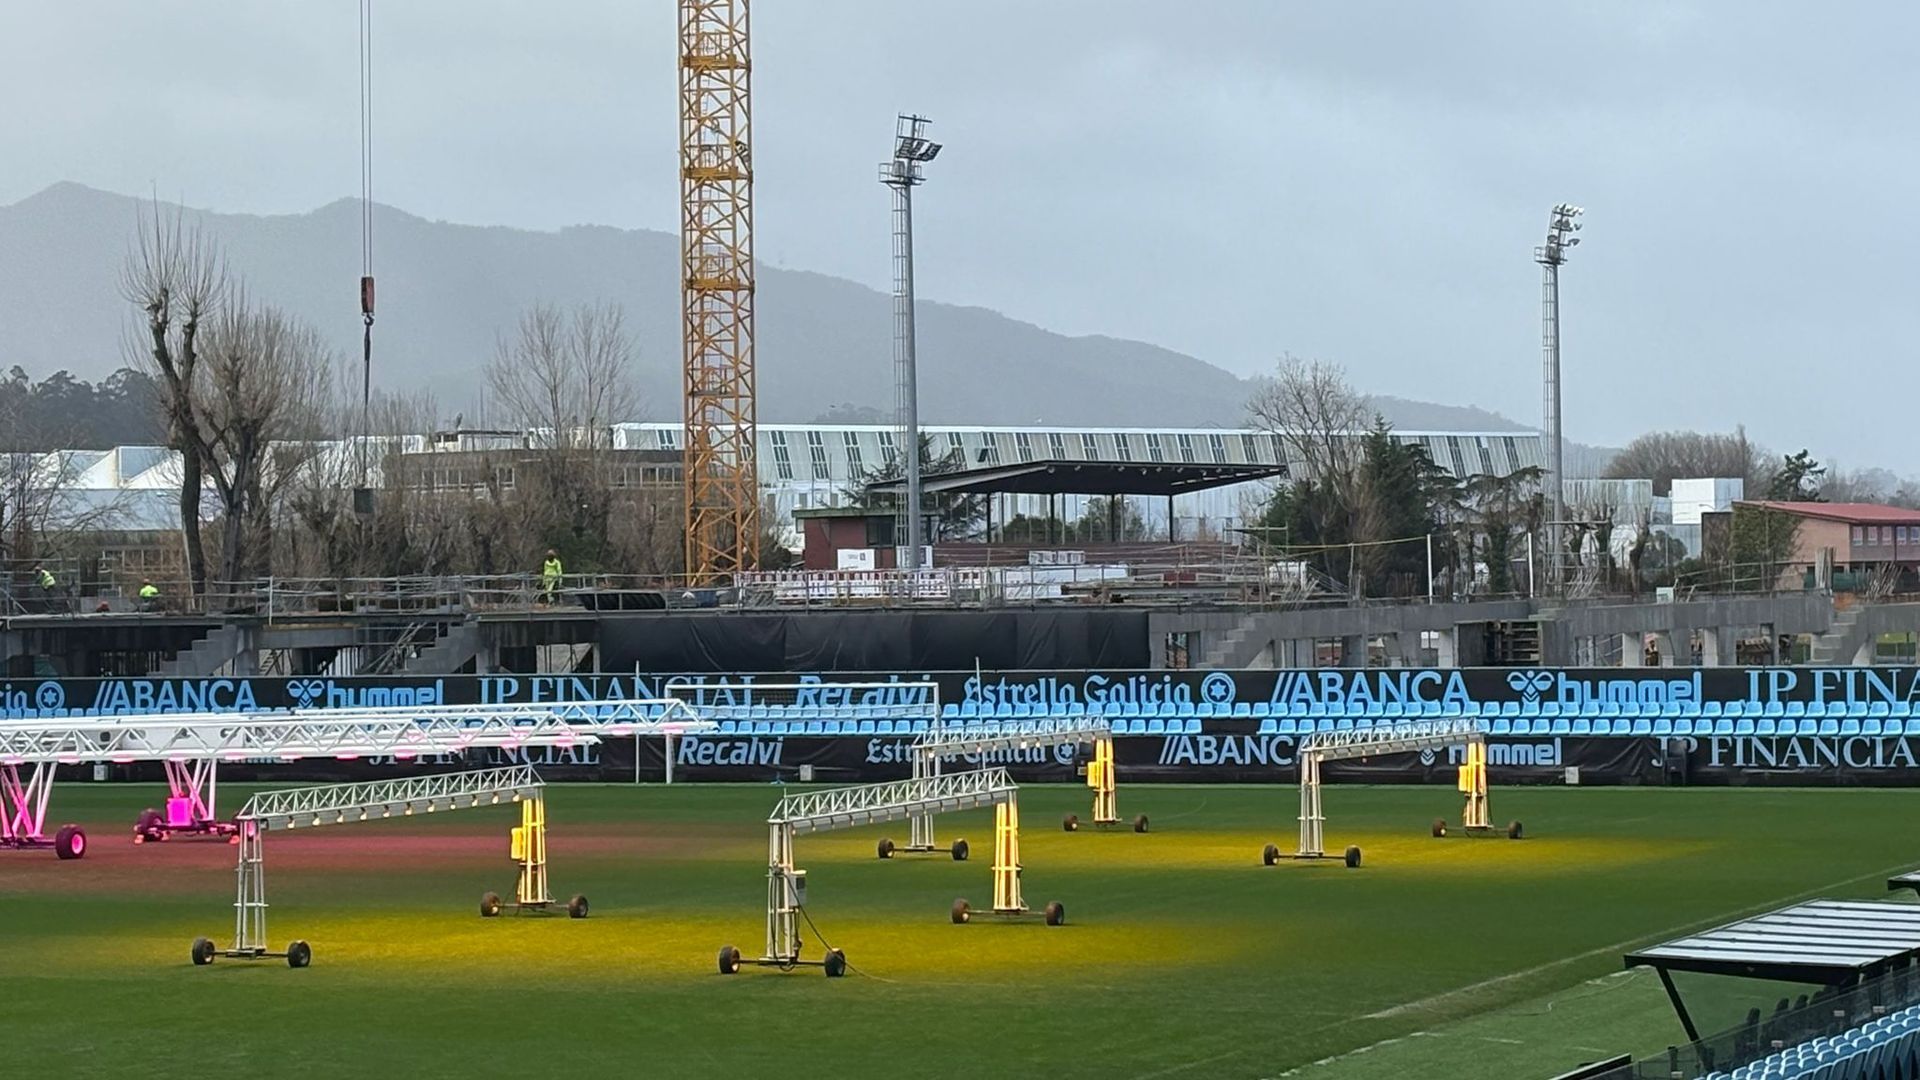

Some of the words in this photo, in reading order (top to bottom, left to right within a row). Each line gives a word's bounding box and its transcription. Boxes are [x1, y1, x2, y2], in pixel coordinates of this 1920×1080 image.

[110, 680, 259, 709] ABANCA
[327, 679, 444, 707] hummel
[795, 674, 931, 706] Recalvi
[963, 675, 1076, 706] Estrella
[1083, 675, 1191, 706] Galicia
[1290, 671, 1471, 705] ABANCA
[1557, 671, 1702, 705] hummel
[1740, 669, 1798, 703] JP
[677, 736, 784, 765] Recalvi
[865, 738, 957, 763] Estr
[1173, 735, 1302, 765] ABANC
[1450, 737, 1562, 765] hmmel
